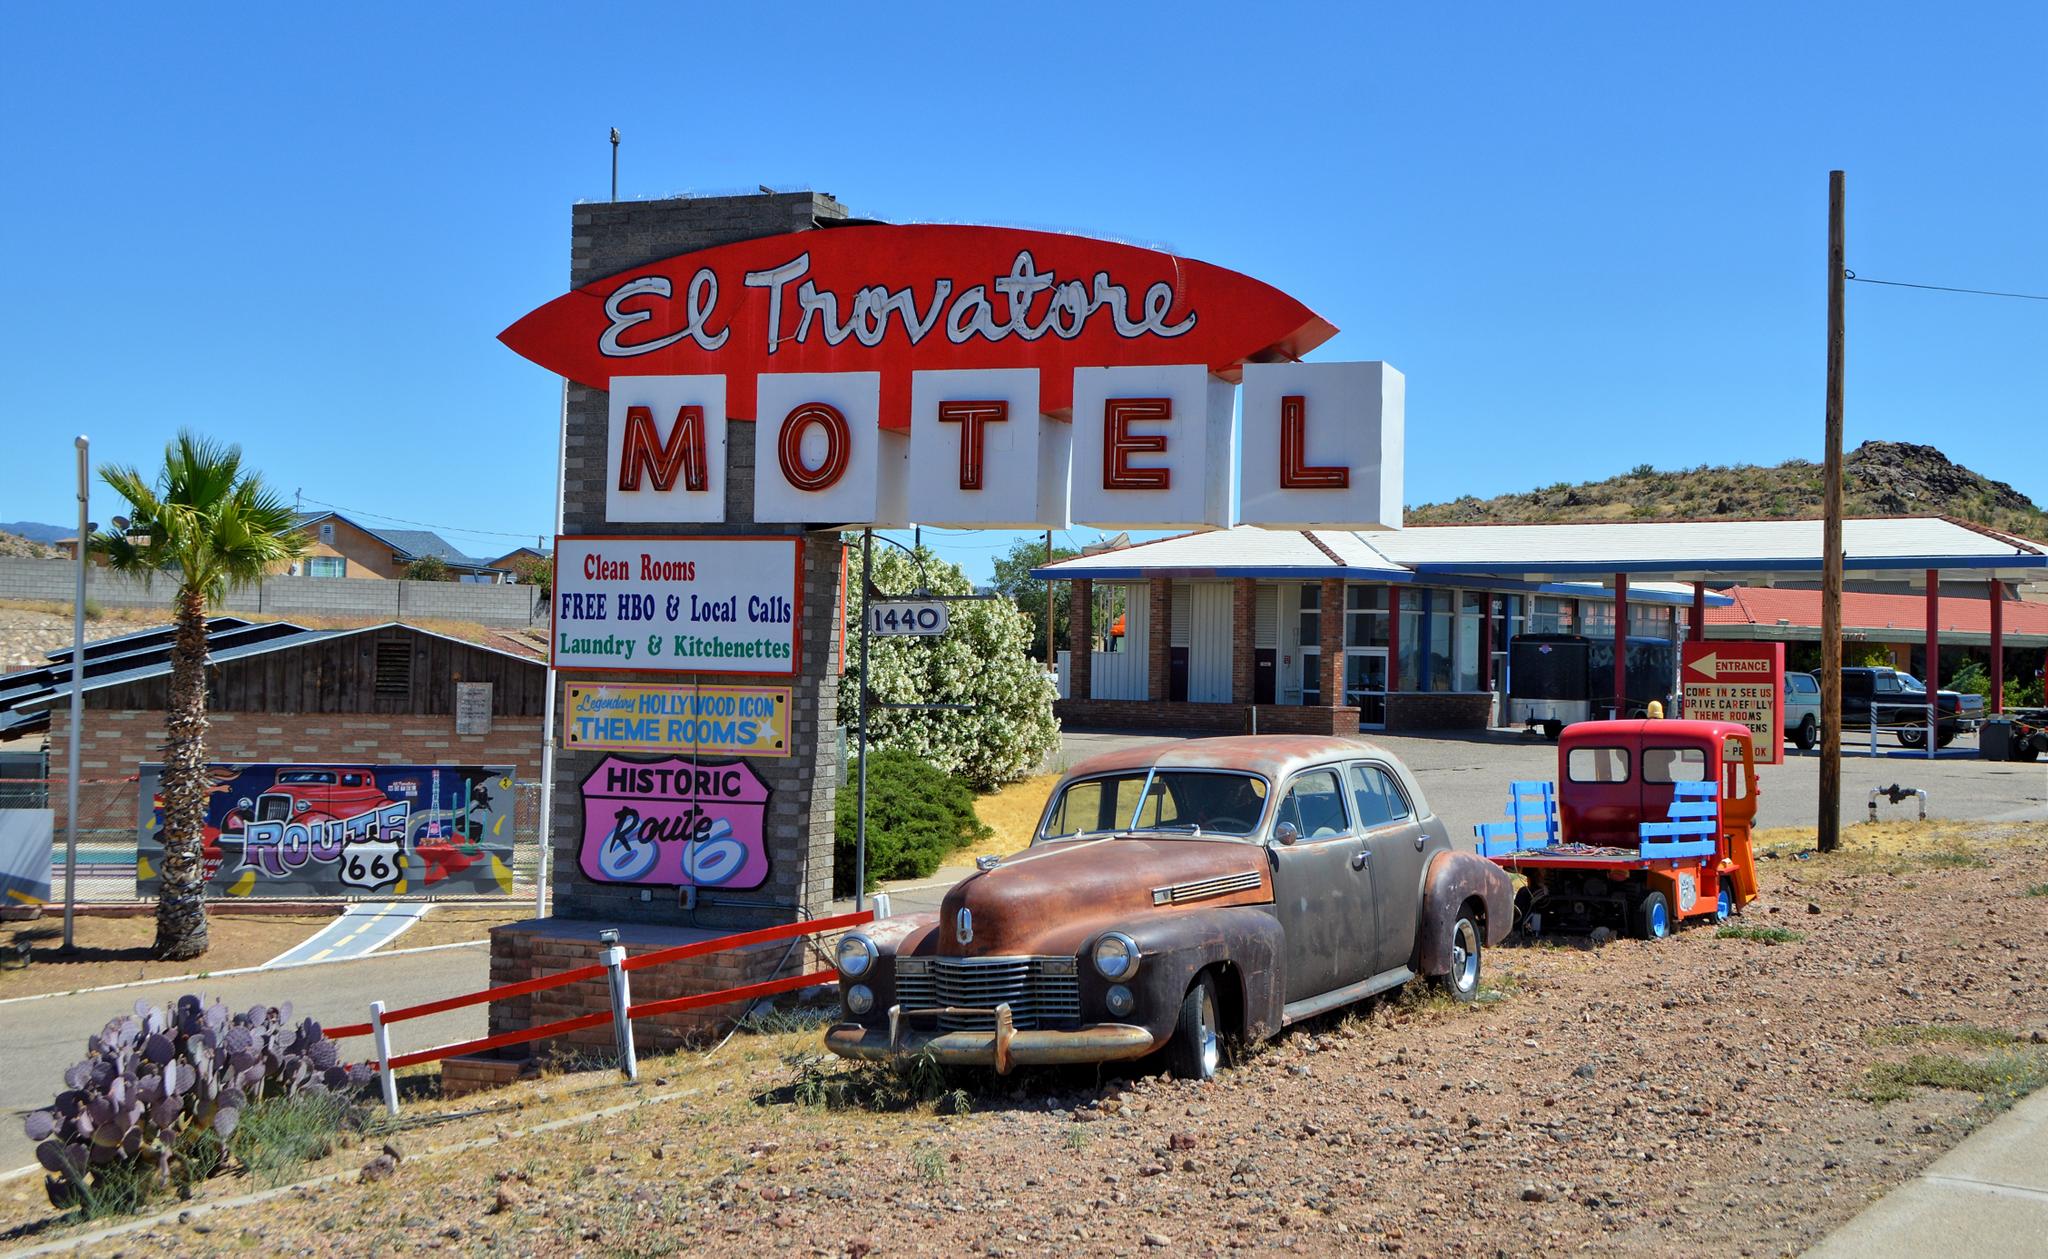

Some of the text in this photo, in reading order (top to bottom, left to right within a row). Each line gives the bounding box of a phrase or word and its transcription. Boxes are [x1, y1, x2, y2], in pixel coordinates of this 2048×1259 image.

[599, 250, 1196, 357] El Trovatore
[618, 395, 1350, 493] MOTEL
[584, 553, 696, 582] Clean Rooms
[560, 593, 792, 624] FREE HBO & Local Calls
[874, 607, 939, 632] 1440
[560, 633, 791, 659] Laundry & Kitchenettes
[1715, 661, 1767, 671] ENTRANCE
[576, 694, 774, 717] Legendary HOLLYWOOD ICON
[1685, 687, 1771, 697] COME IN 2 SEE US
[1685, 699, 1773, 710] DRIVE CAREFULLY
[1694, 711, 1762, 721] THEME ROOMS
[575, 716, 759, 745] THEME ROOMS
[1754, 747, 1766, 757] OK
[606, 767, 741, 797] HISTORIC
[234, 801, 410, 878] ROUTE
[609, 806, 713, 853] Route
[600, 817, 750, 885] 66
[348, 854, 390, 880] 66
